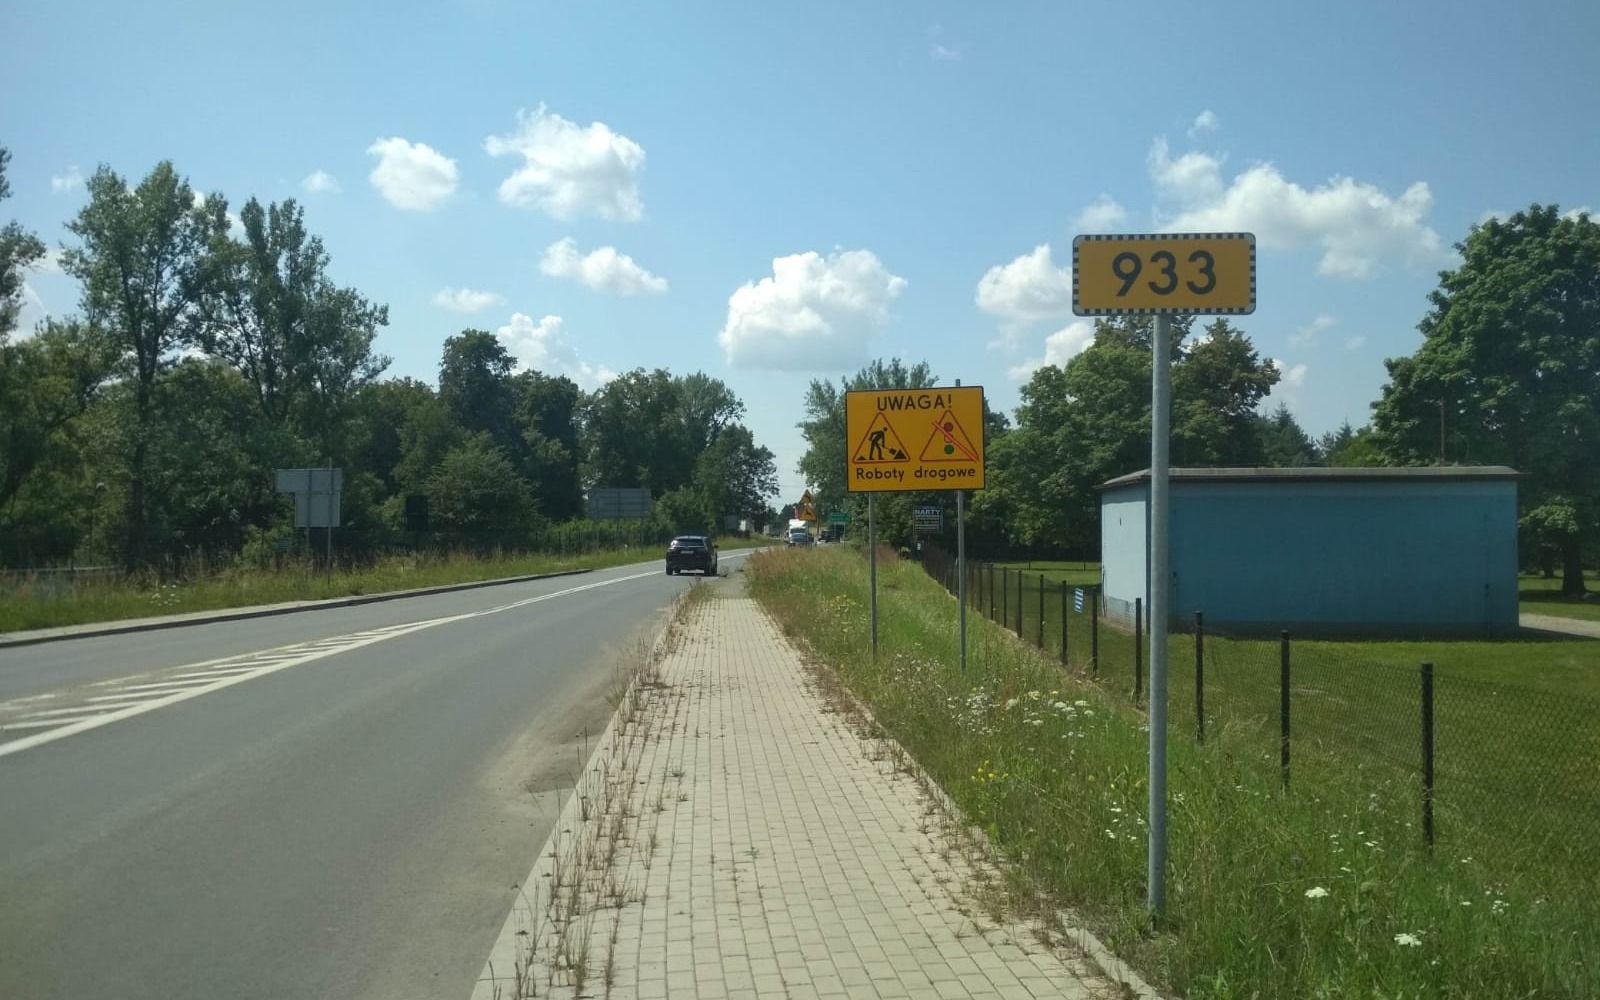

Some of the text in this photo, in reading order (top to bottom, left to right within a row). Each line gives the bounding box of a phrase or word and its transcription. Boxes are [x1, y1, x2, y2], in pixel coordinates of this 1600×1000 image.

[1112, 250, 1217, 297] 933
[877, 393, 952, 411] UWAGA!
[856, 466, 976, 482] Roboty drogowe
